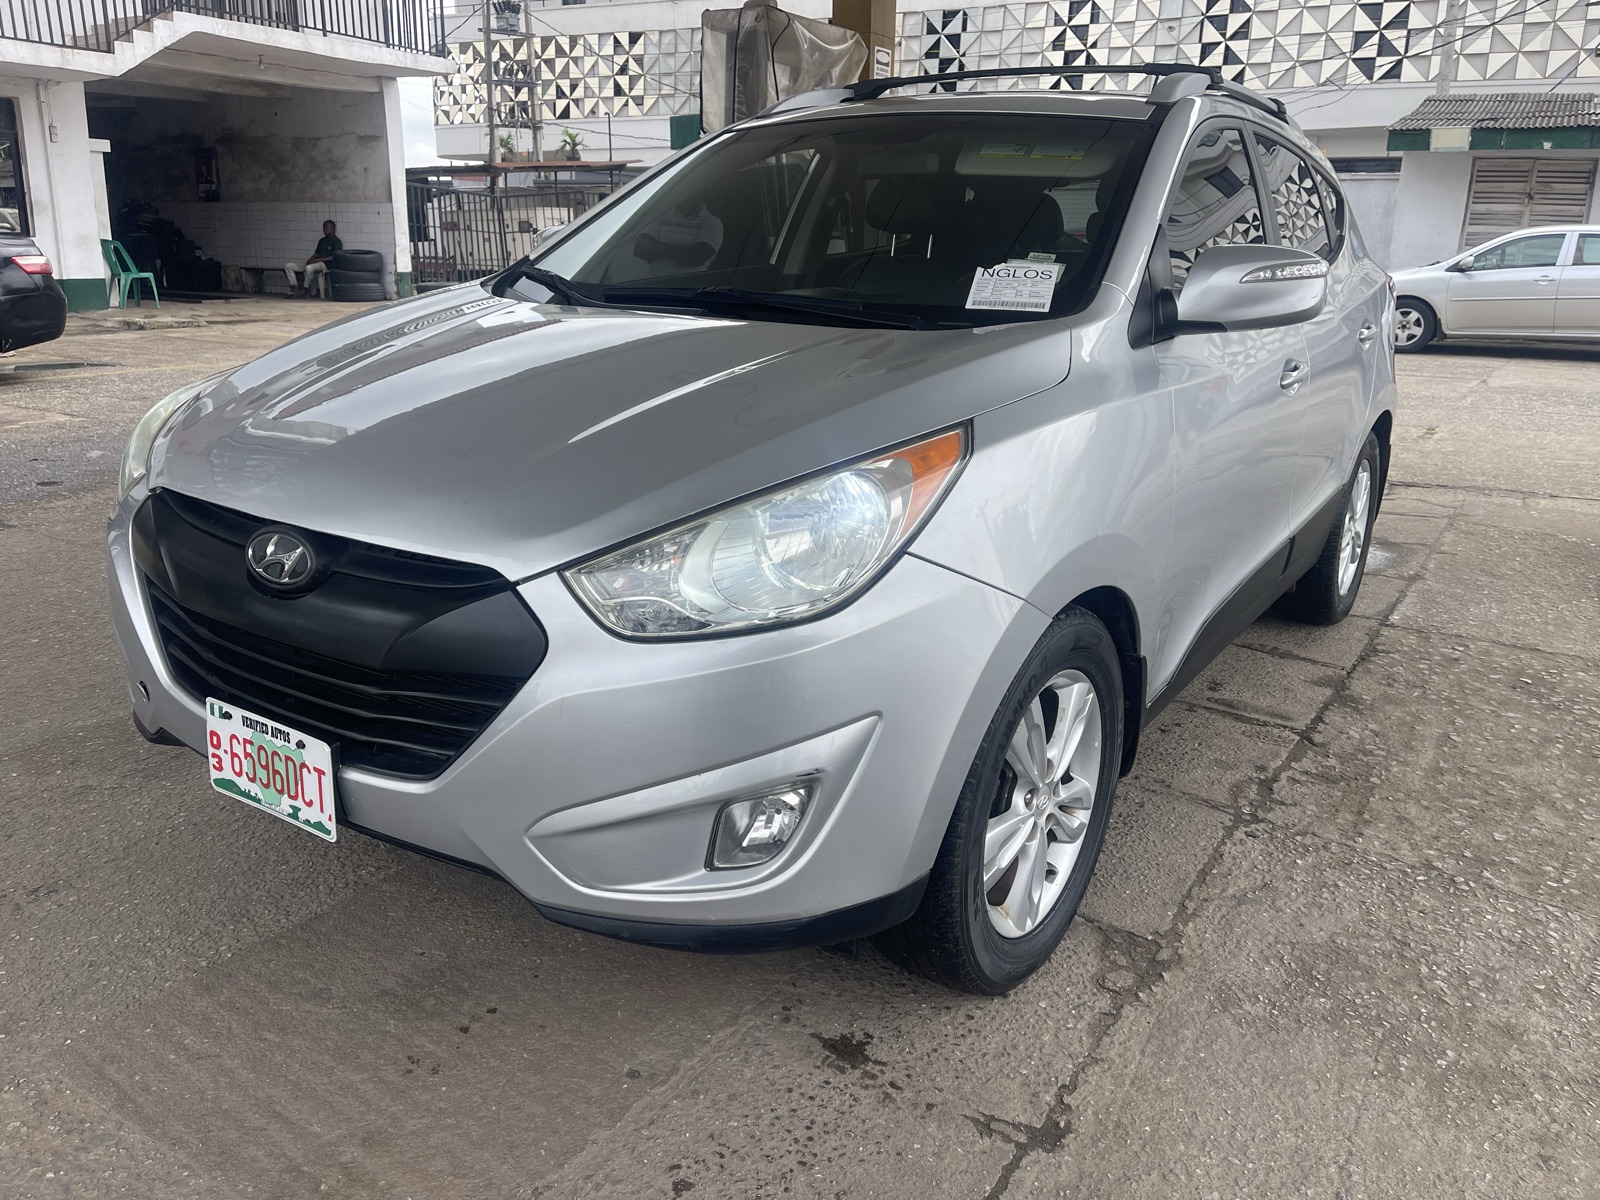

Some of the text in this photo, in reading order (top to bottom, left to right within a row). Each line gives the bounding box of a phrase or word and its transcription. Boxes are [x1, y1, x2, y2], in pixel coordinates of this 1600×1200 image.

[981, 268, 1053, 280] NGLOS
[241, 714, 291, 744] VERIFIED AUTOS
[990, 673, 1037, 774] KUMHO
